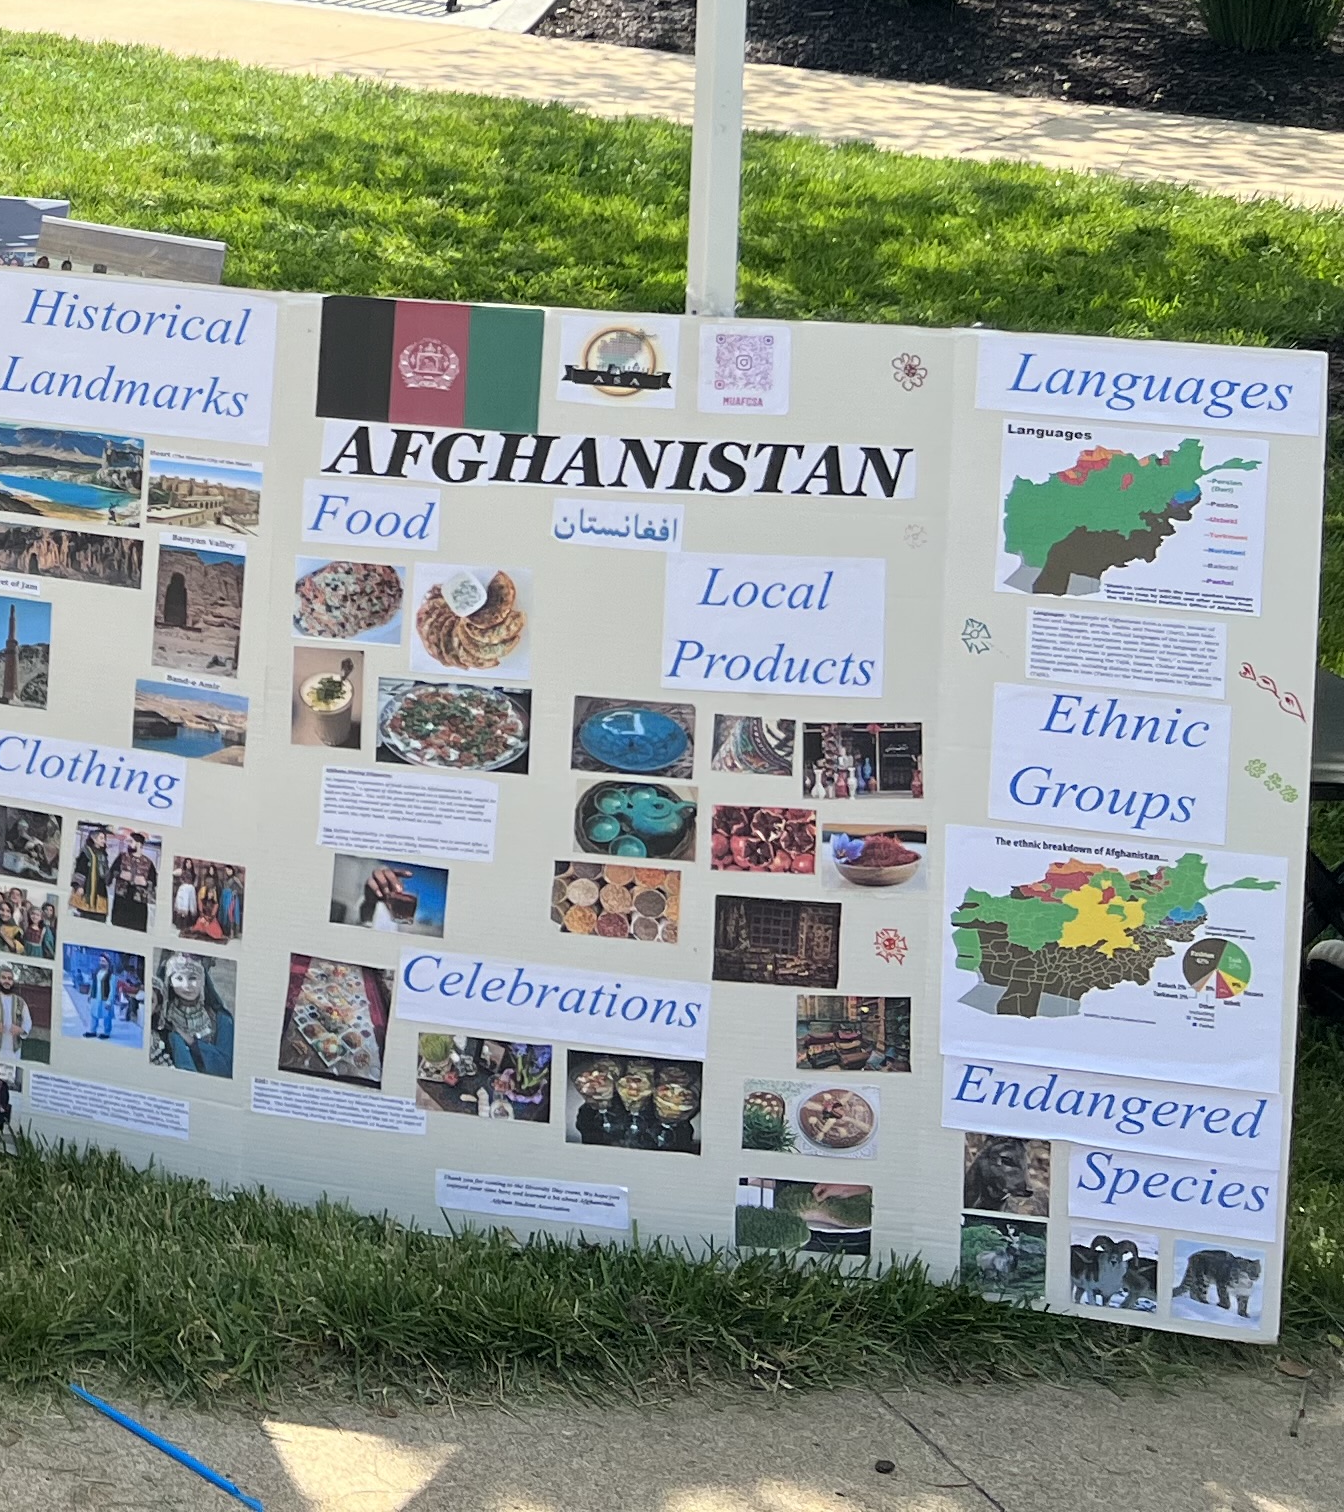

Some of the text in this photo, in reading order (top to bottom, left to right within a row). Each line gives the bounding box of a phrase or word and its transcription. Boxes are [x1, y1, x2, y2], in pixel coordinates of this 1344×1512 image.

[22, 287, 252, 347] Historical
[1006, 351, 1294, 418] Languages
[1007, 425, 1092, 441] Languages
[327, 425, 914, 499] AFGHANISTAN
[172, 534, 235, 549] Bamyan Valley
[306, 493, 436, 540] Food
[554, 508, 678, 542] افغانستان
[20, 582, 38, 591] Jam
[696, 567, 834, 611] Local
[166, 674, 221, 690] Band-e Amir
[665, 639, 875, 691] Products
[1040, 694, 1210, 749] Ethnic
[1008, 765, 1196, 828] Groups
[995, 836, 1012, 846] The
[1013, 839, 1041, 850] ethnic
[1042, 842, 1092, 854] breakdown
[1094, 847, 1104, 855] of
[402, 954, 703, 1030] Celebrations
[952, 1063, 1268, 1141] Endangered
[1076, 1151, 1271, 1213] Species
